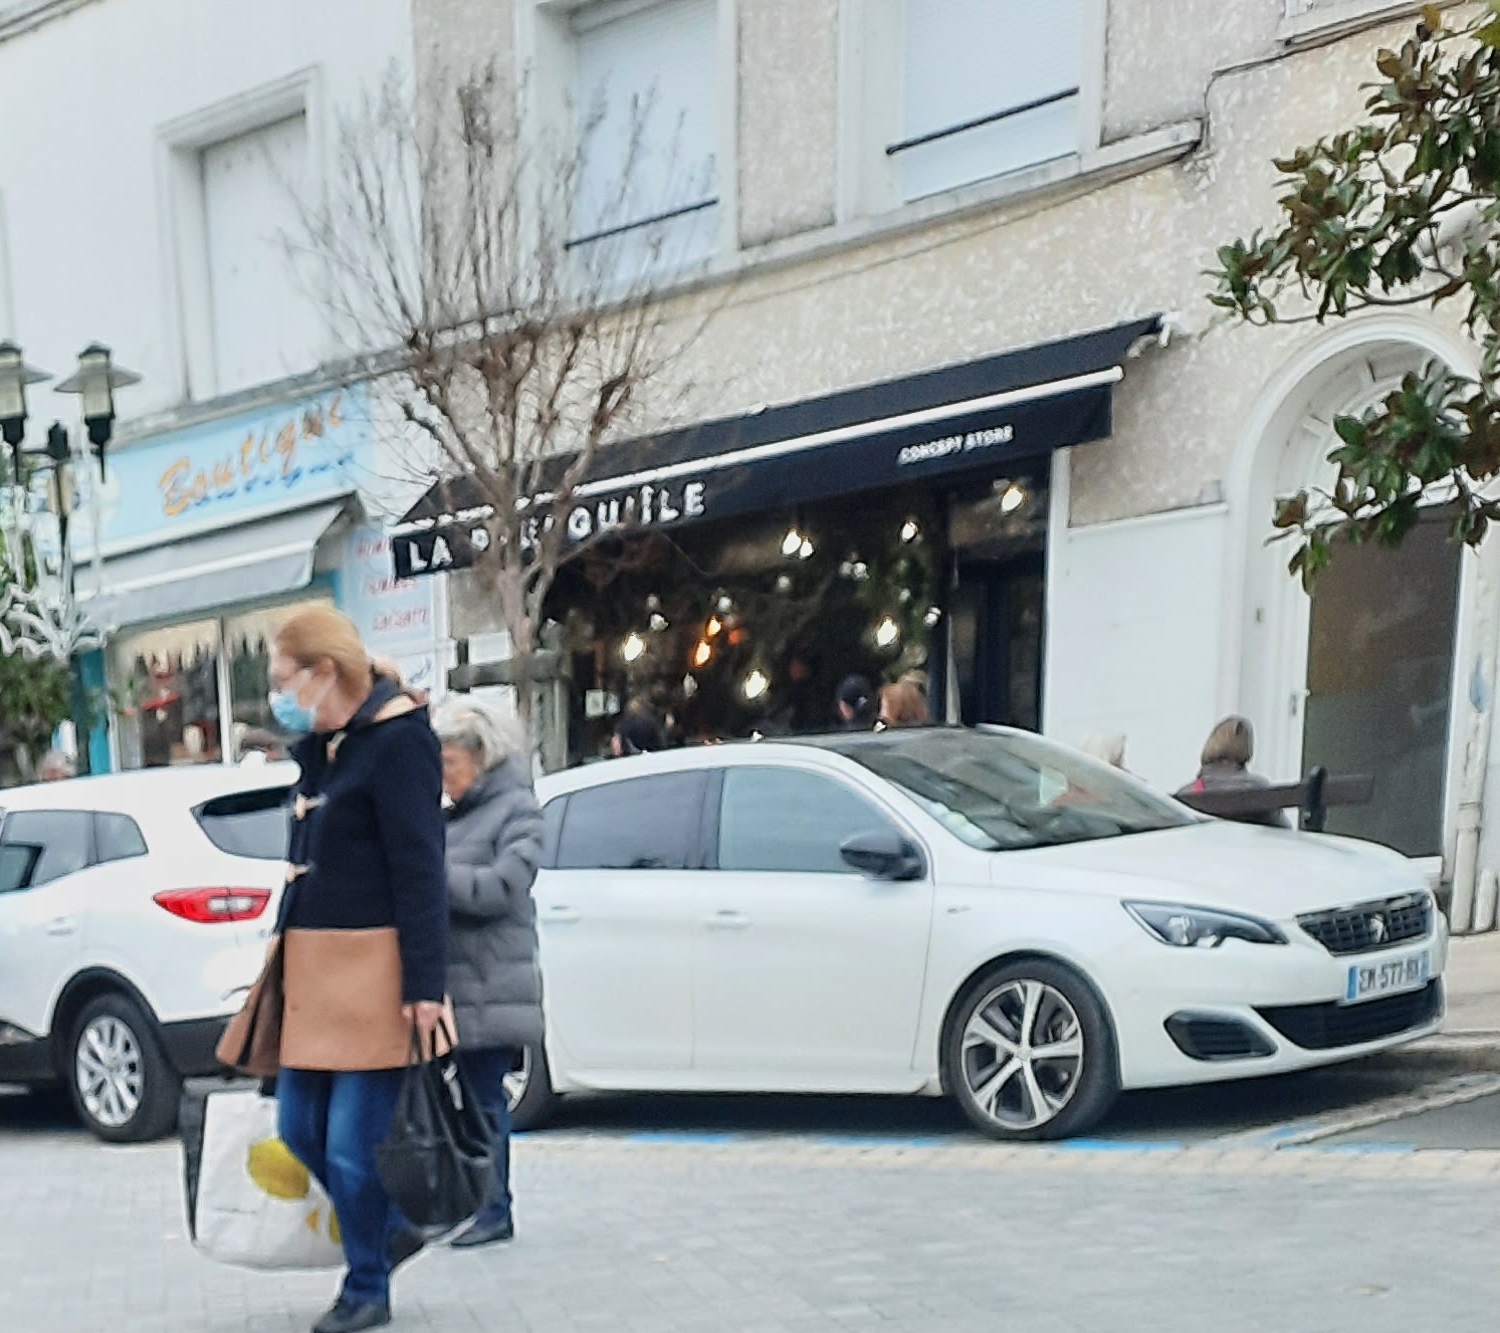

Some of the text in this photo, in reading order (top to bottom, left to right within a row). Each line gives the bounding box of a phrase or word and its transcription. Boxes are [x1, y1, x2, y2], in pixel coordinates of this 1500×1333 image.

[898, 423, 1014, 465] CONCEPT STORE
[407, 534, 454, 572] LA
